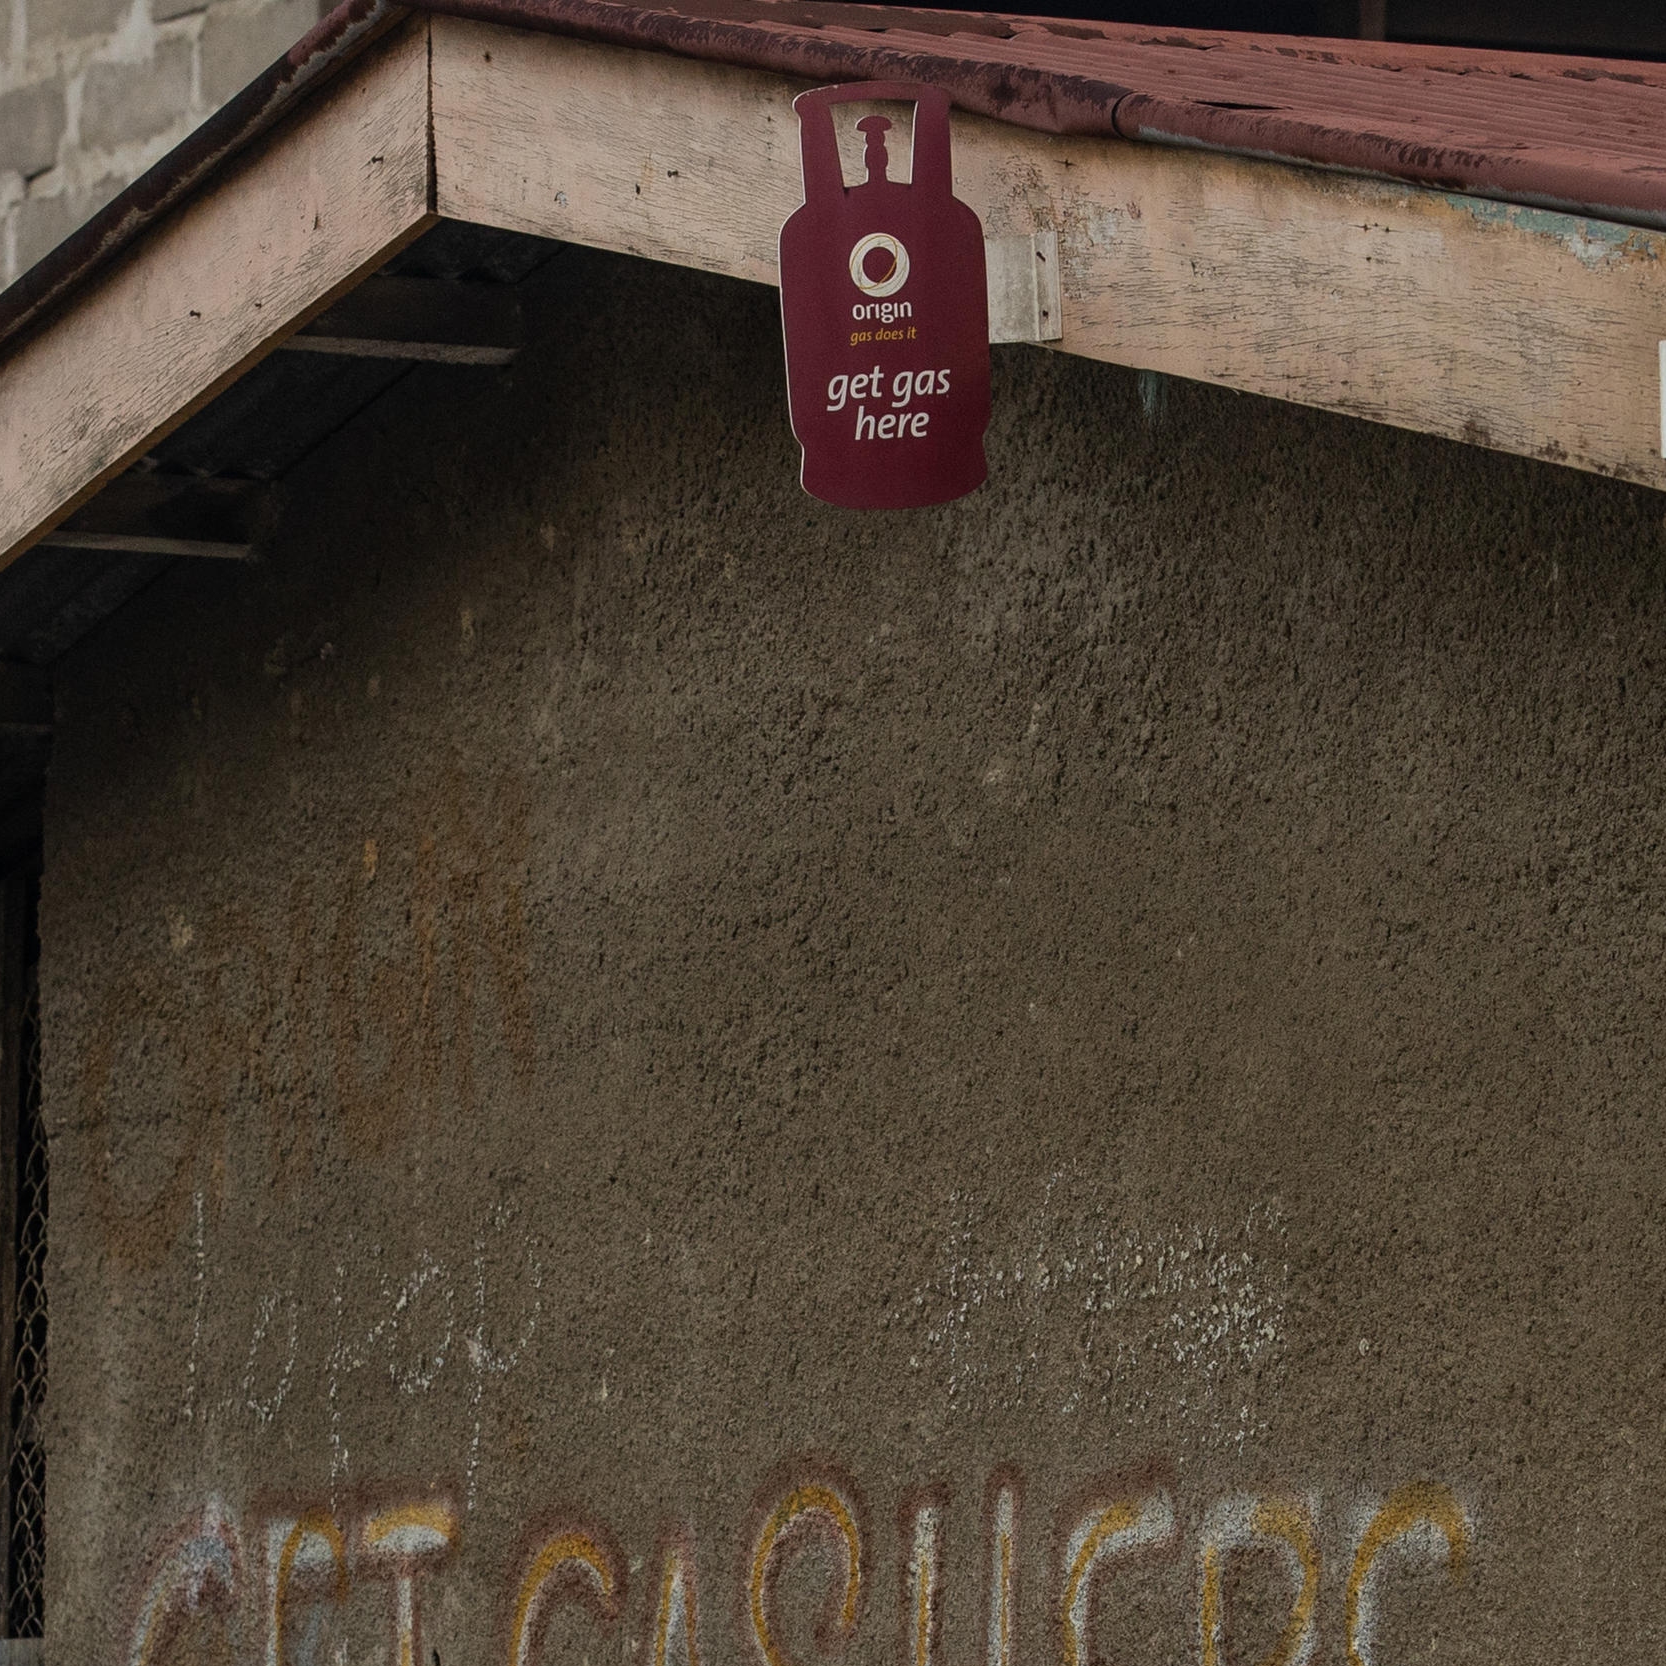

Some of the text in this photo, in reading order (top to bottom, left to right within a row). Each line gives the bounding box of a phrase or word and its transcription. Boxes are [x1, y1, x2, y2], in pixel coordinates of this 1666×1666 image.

[851, 300, 913, 324] origin
[849, 325, 917, 347] gas does it
[826, 364, 952, 413] get gas
[853, 405, 930, 441] here
